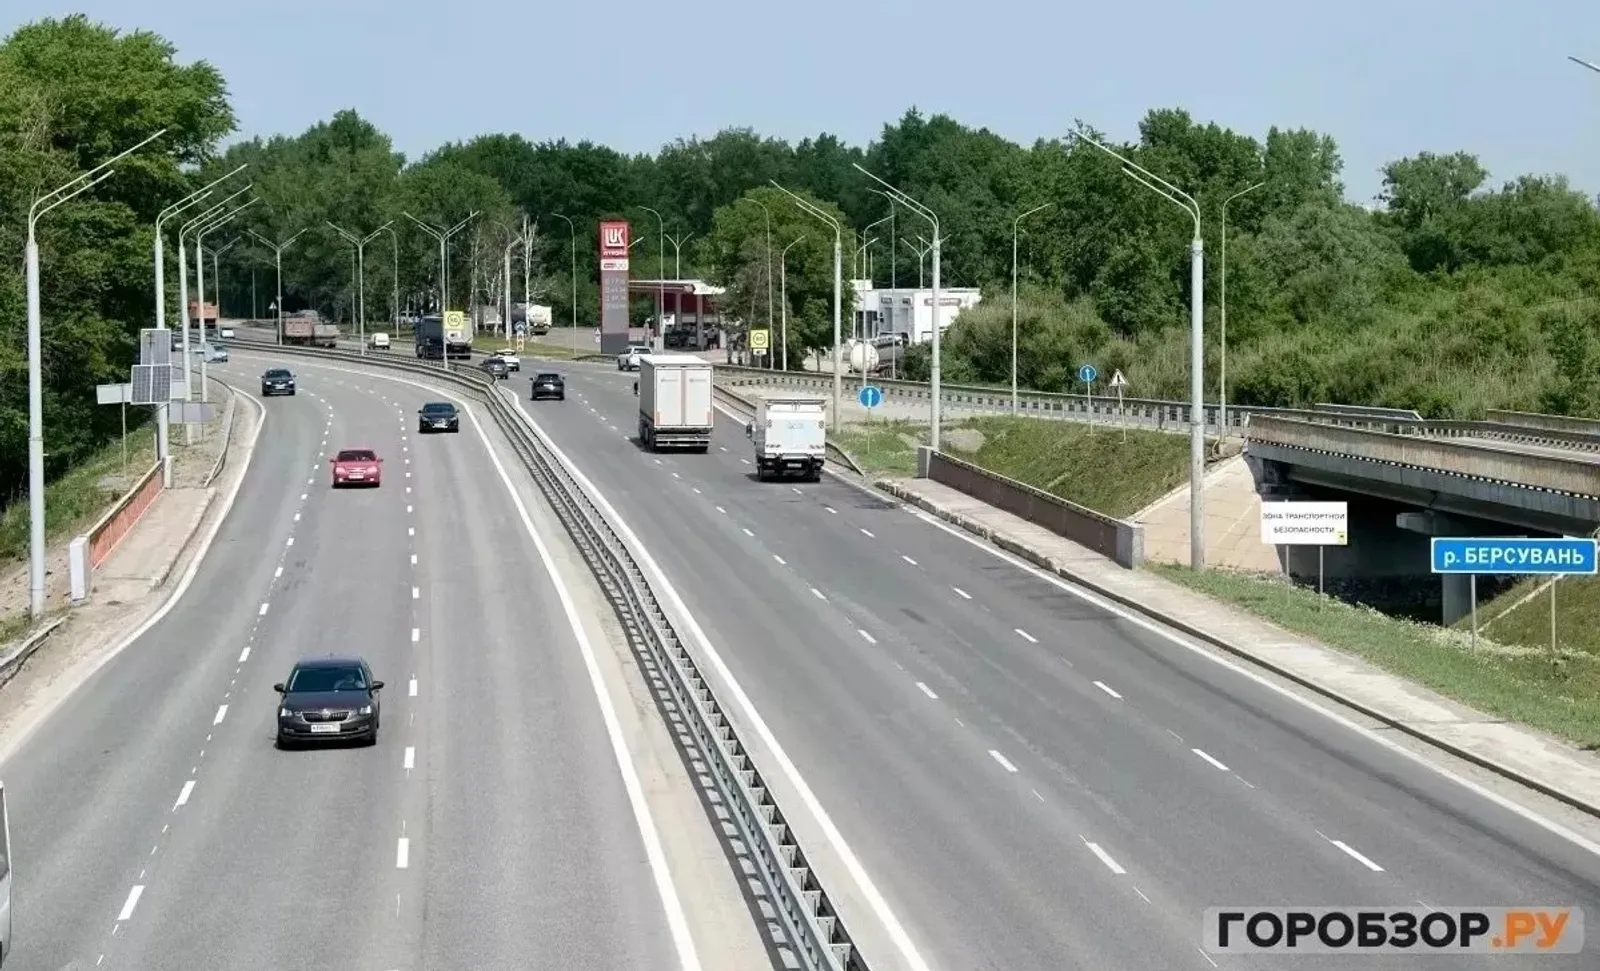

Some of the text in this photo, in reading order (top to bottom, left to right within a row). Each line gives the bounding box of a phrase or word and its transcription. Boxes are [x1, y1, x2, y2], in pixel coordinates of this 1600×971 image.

[1273, 526, 1335, 534] БЕЗОПАСНОСТИ
[1444, 548, 1584, 568] р. БЕРСУВАНЬ
